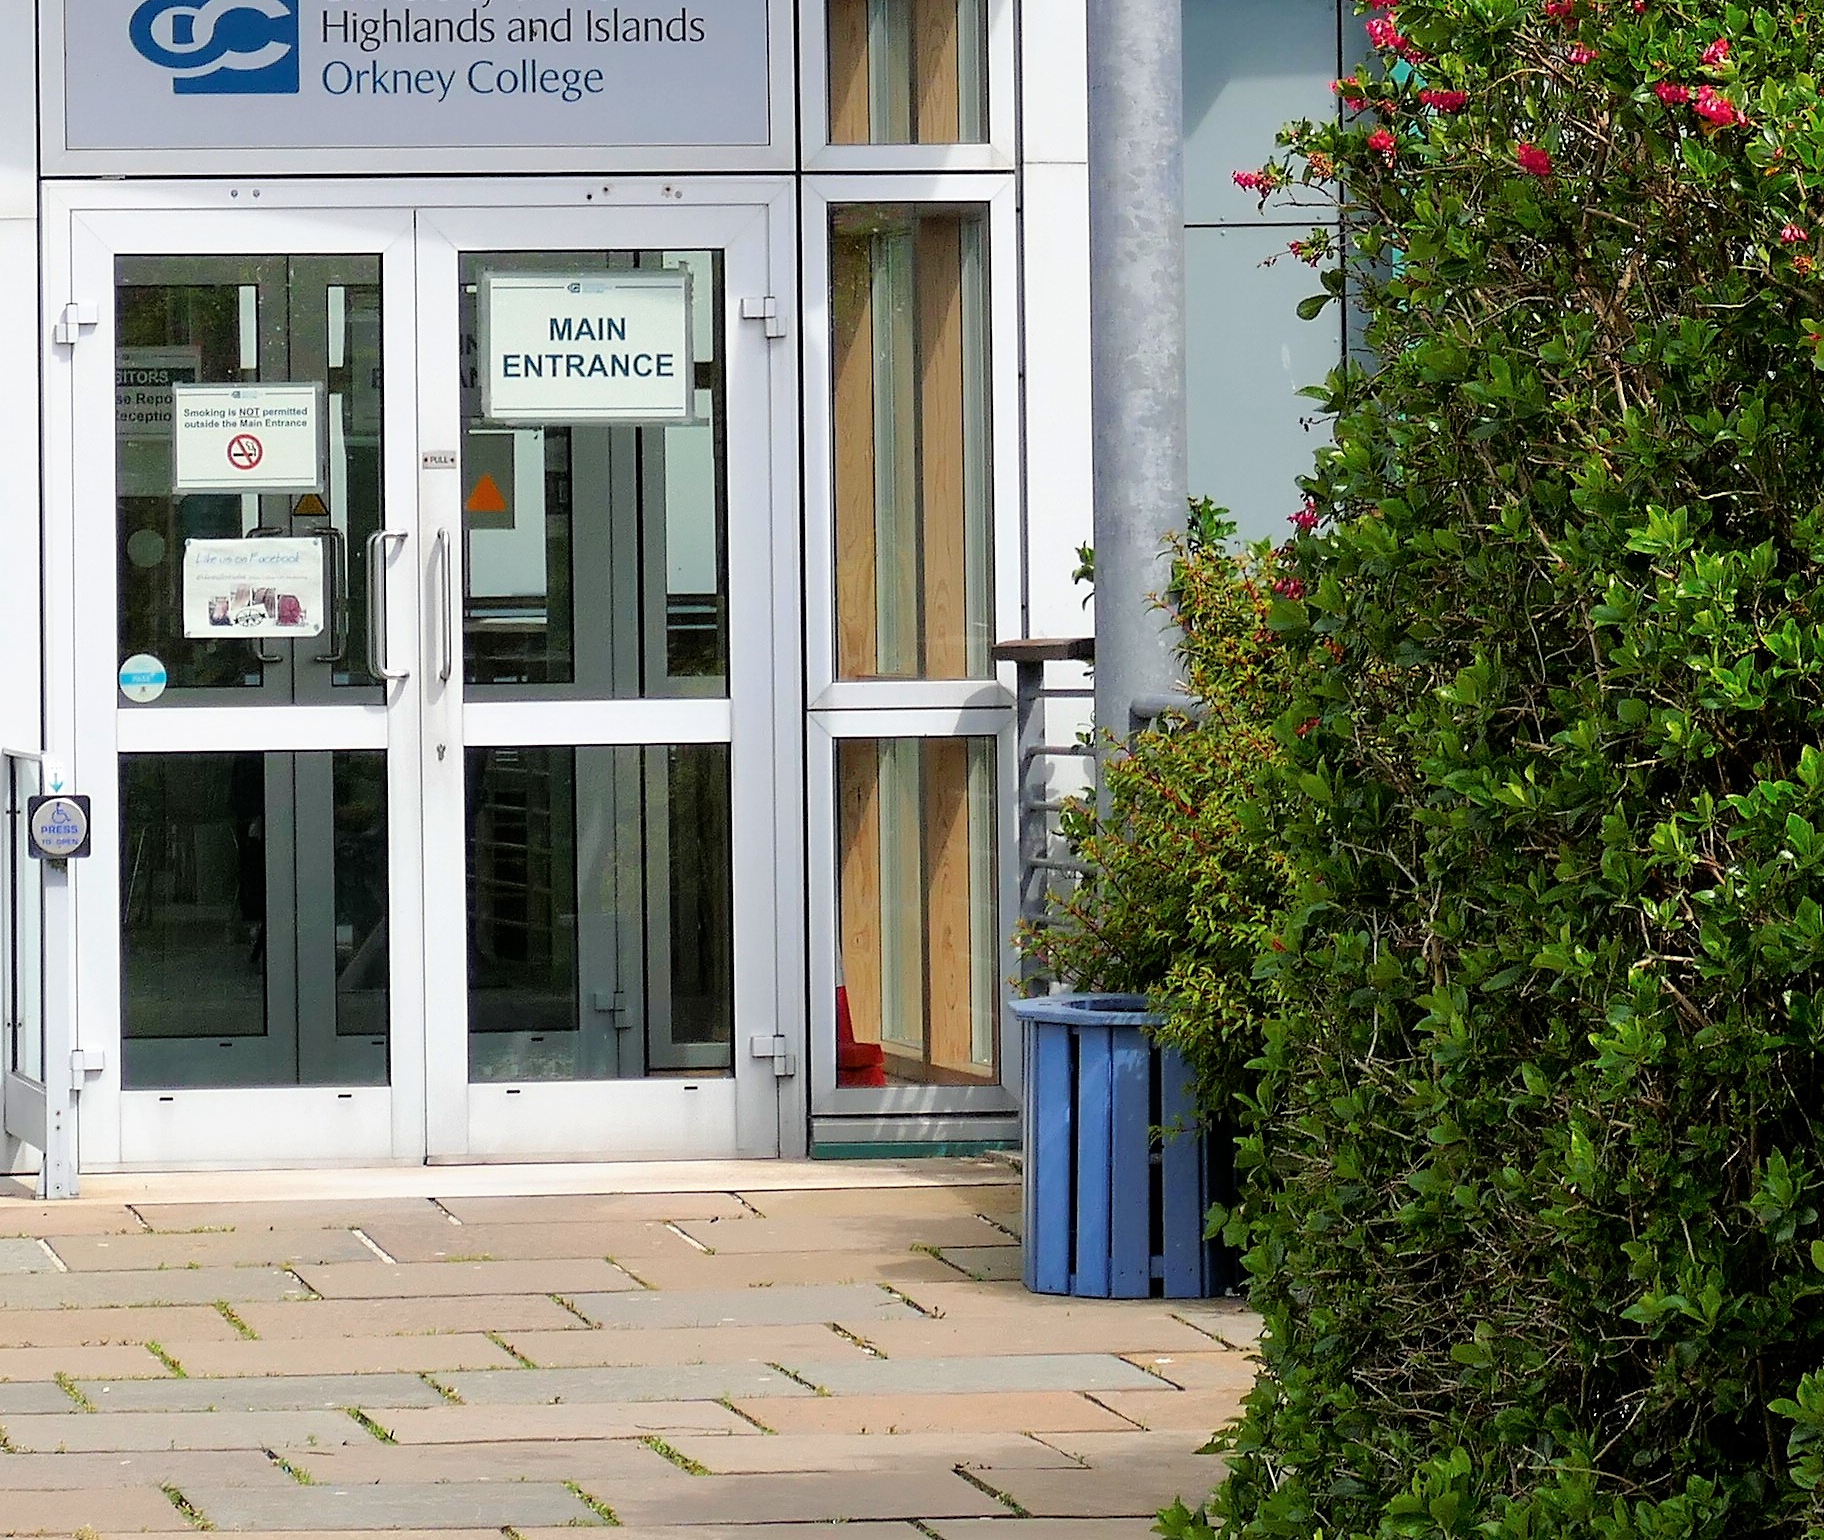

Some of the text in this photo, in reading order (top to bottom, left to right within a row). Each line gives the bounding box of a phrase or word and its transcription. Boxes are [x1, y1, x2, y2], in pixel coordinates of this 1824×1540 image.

[321, 7, 706, 53] Highlands and Islands
[321, 59, 605, 103] Orkney College
[549, 317, 626, 341] MAIN
[502, 353, 674, 378] ENTRANCE
[116, 371, 169, 384] SITORS
[136, 392, 172, 407] Repo
[116, 410, 172, 425] eceptio
[184, 407, 308, 419] Smoking is NOT permitted
[184, 419, 308, 429] outside the Main Entrance
[430, 456, 448, 464] PULL
[195, 551, 300, 564] Like us on Facebook
[41, 825, 78, 834] PRESS
